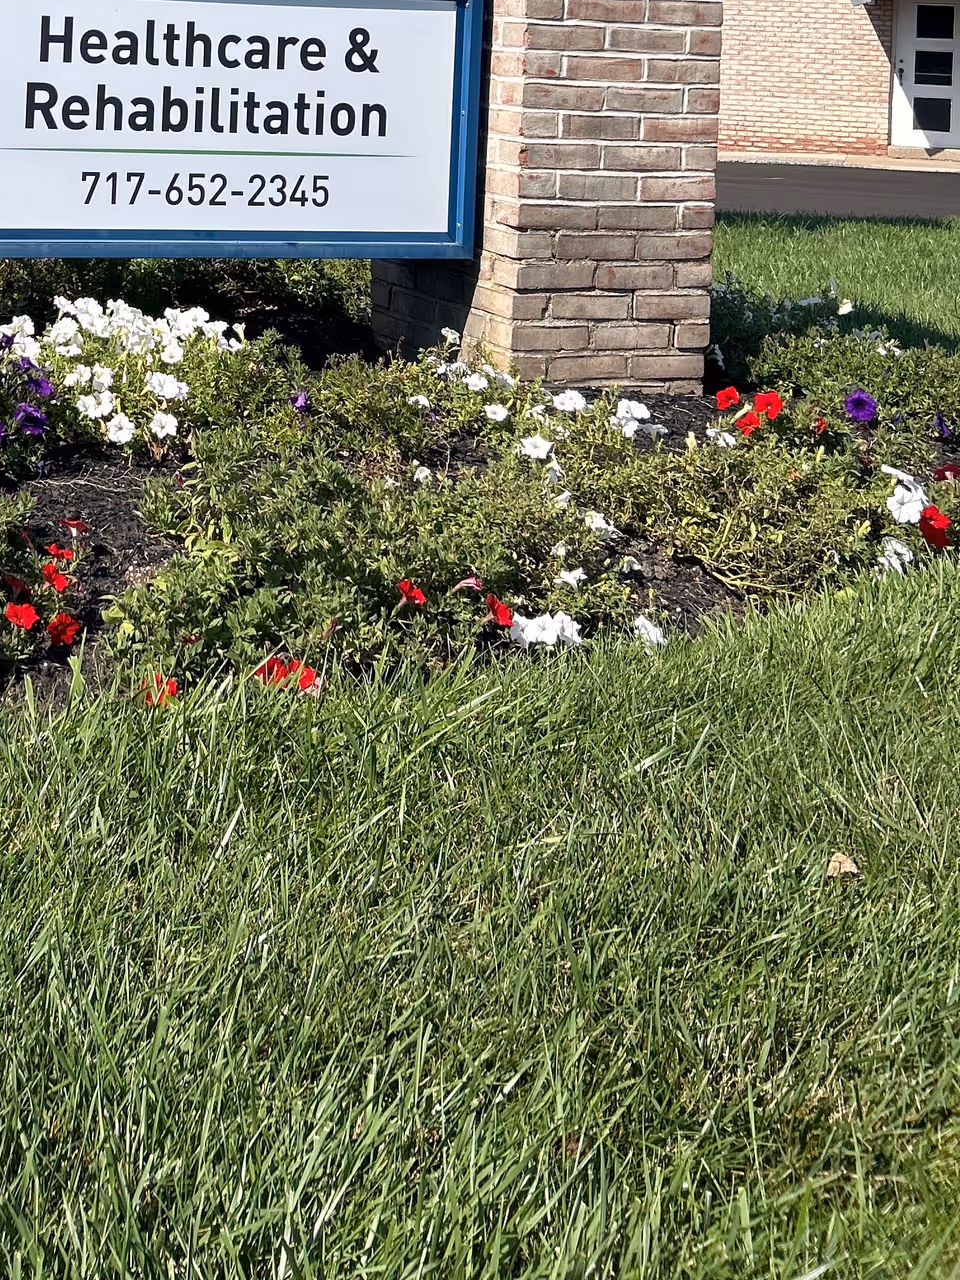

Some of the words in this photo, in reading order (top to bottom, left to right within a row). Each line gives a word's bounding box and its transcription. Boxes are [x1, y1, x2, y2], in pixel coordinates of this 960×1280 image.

[39, 15, 327, 71] Healthcare
[344, 27, 380, 73] &
[24, 82, 387, 137] Rehabilitation
[81, 171, 330, 207] 717-652-2345
